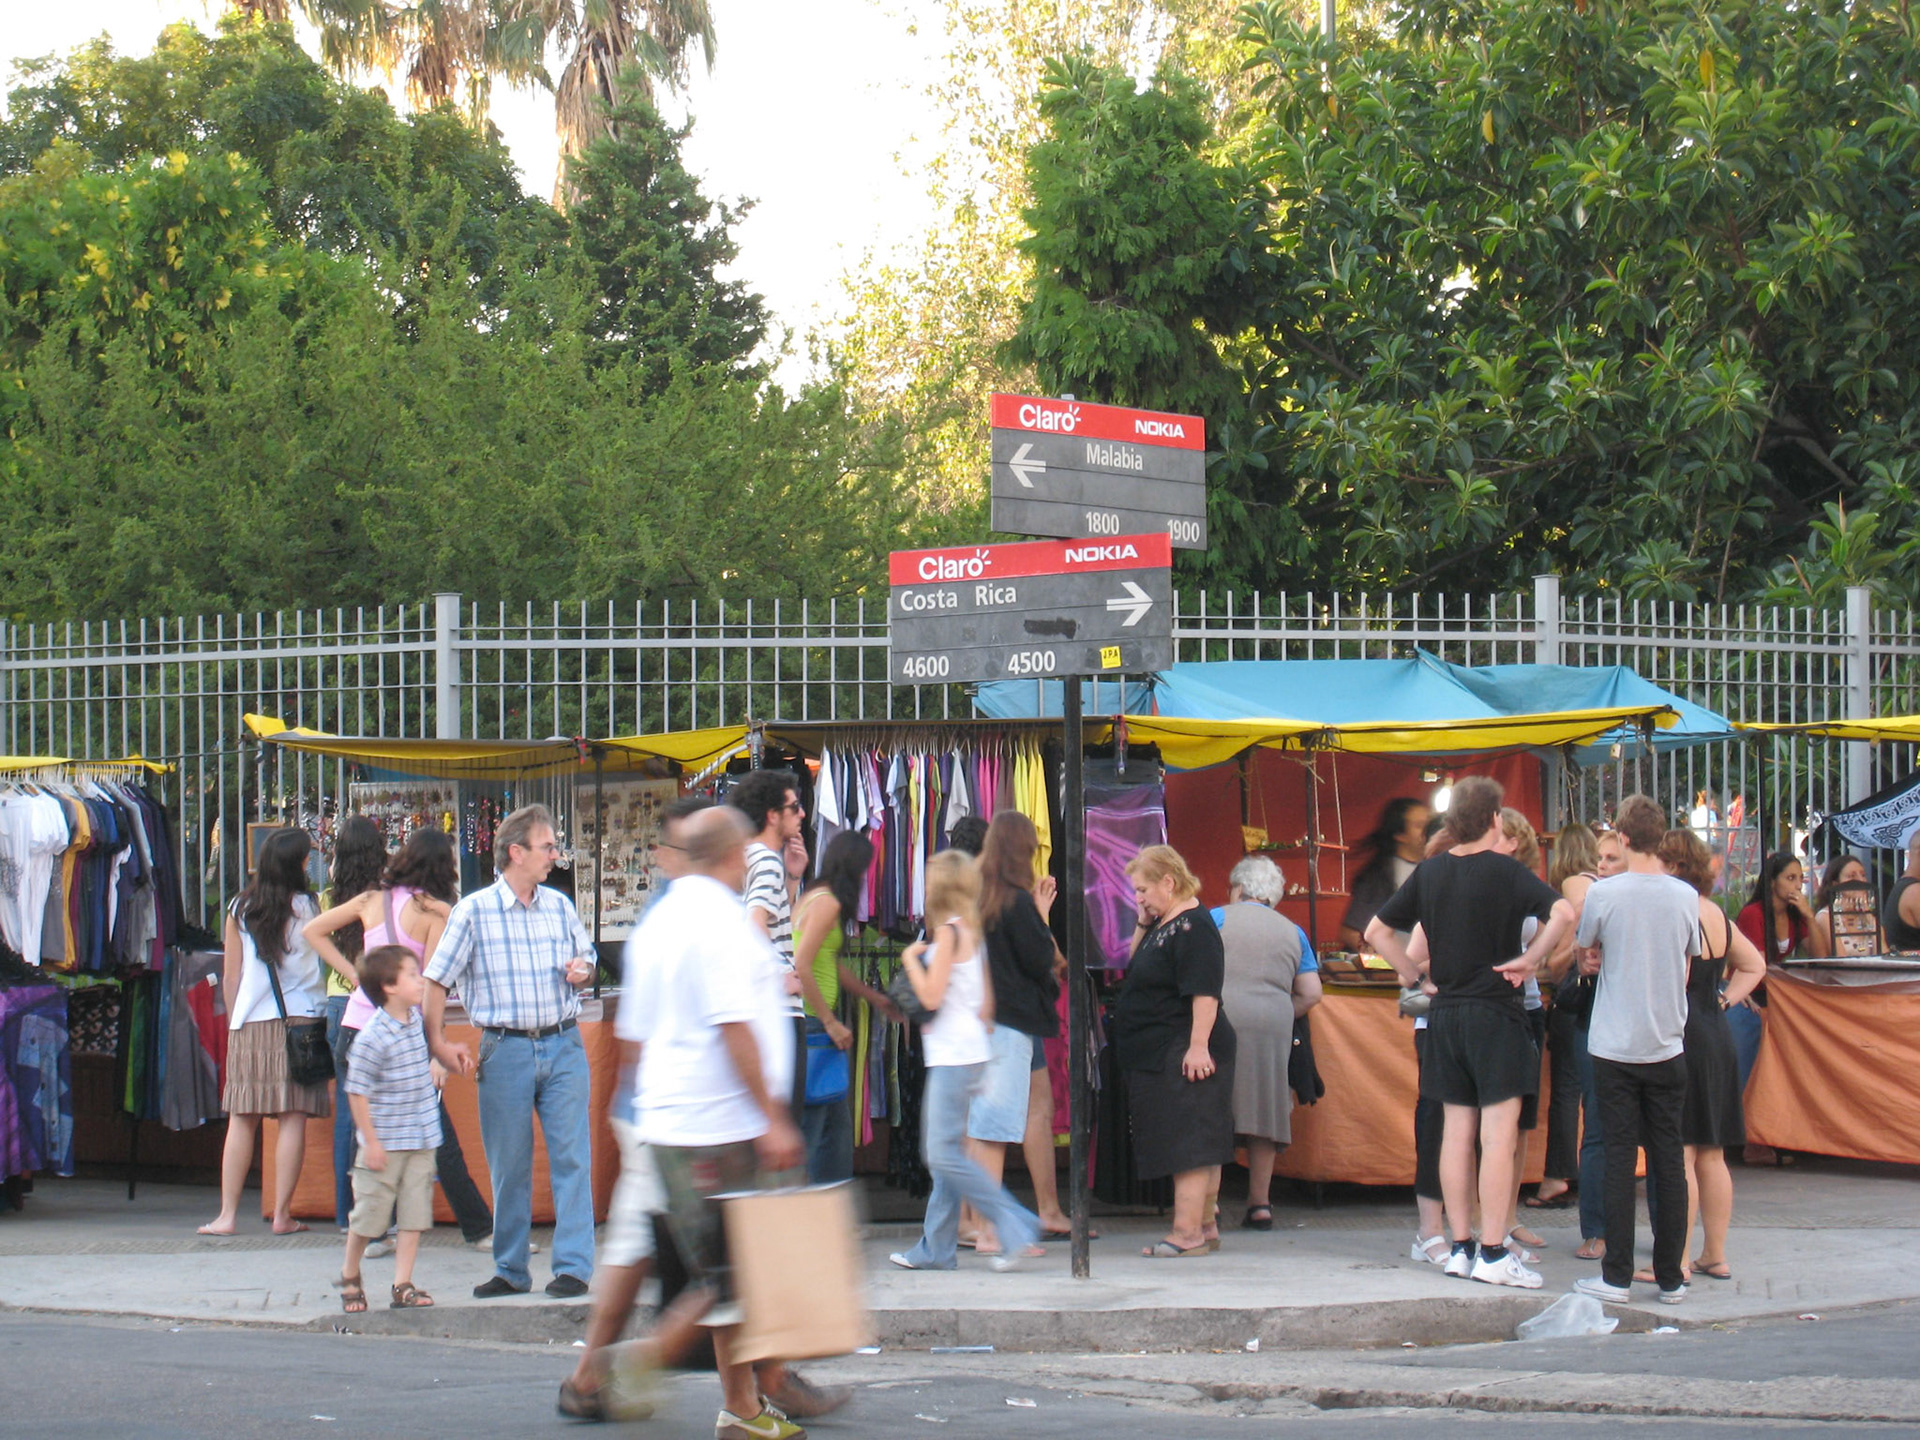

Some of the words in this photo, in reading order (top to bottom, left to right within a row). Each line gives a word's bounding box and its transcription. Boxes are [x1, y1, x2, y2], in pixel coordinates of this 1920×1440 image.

[1019, 404, 1081, 432] Claro
[1135, 419, 1185, 439] NOKIA
[1086, 443, 1144, 471] Malabia
[1085, 511, 1120, 536] 1800
[1167, 519, 1200, 543] 1900
[918, 549, 992, 580] Claro
[1065, 544, 1138, 564] NOKIA
[900, 589, 958, 612] Costa
[975, 585, 1017, 607] Rica
[903, 655, 950, 678] 4600
[1008, 650, 1056, 675] 4500
